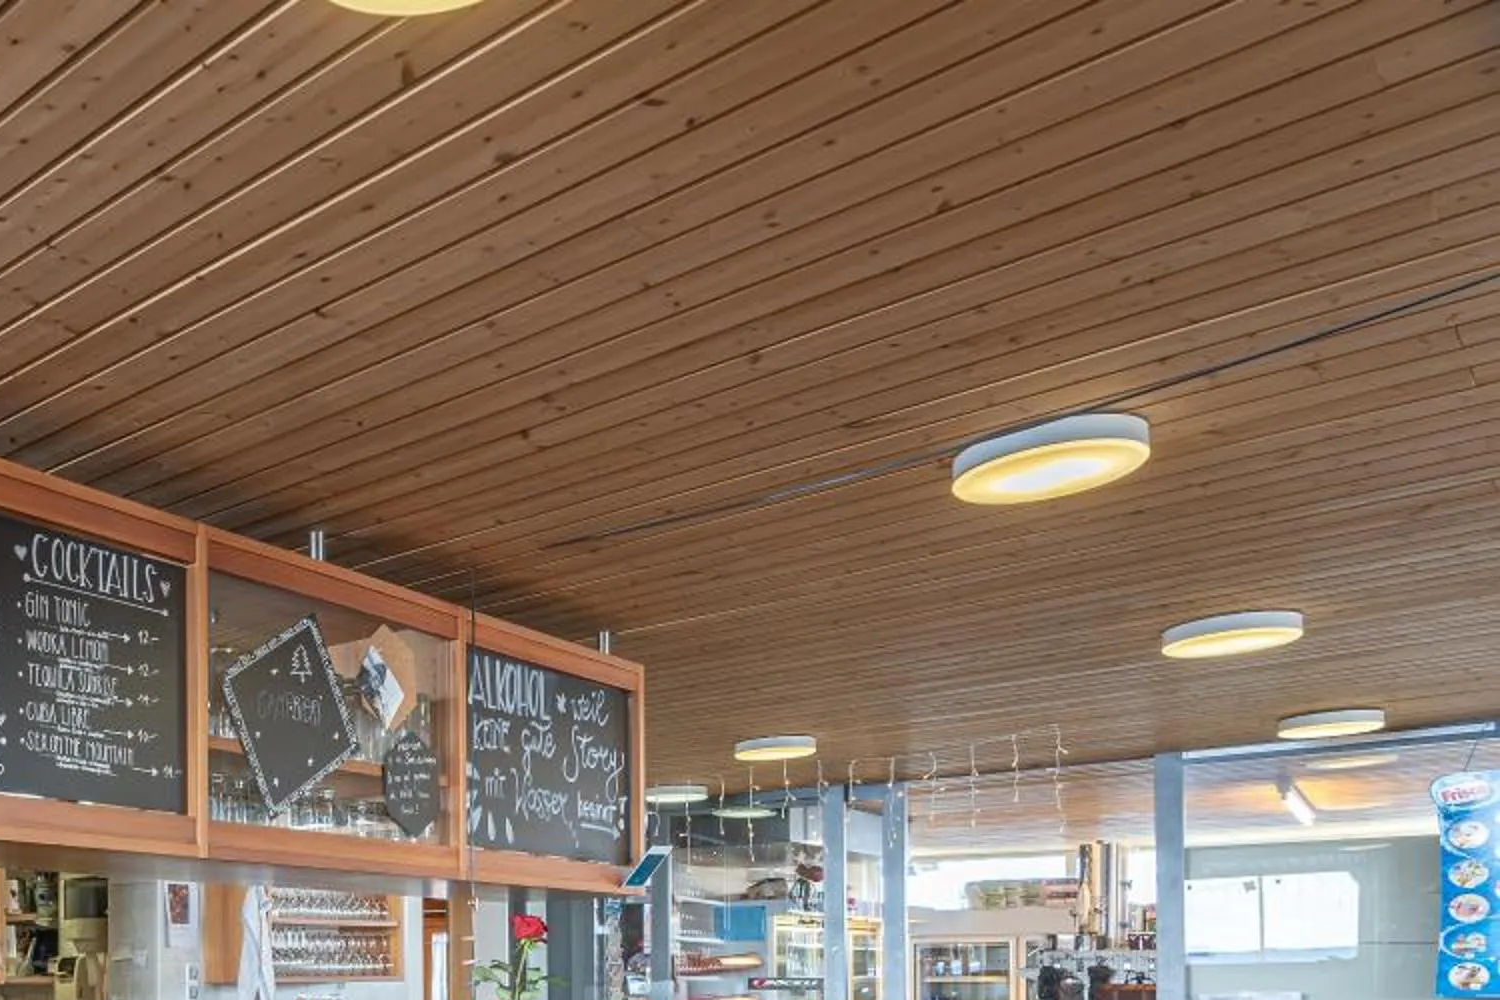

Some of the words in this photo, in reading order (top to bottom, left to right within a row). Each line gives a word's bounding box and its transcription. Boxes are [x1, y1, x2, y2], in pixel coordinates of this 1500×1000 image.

[31, 533, 158, 603] COCKTAILS
[468, 653, 551, 721] ALKOHOL
[563, 724, 625, 801] Story
